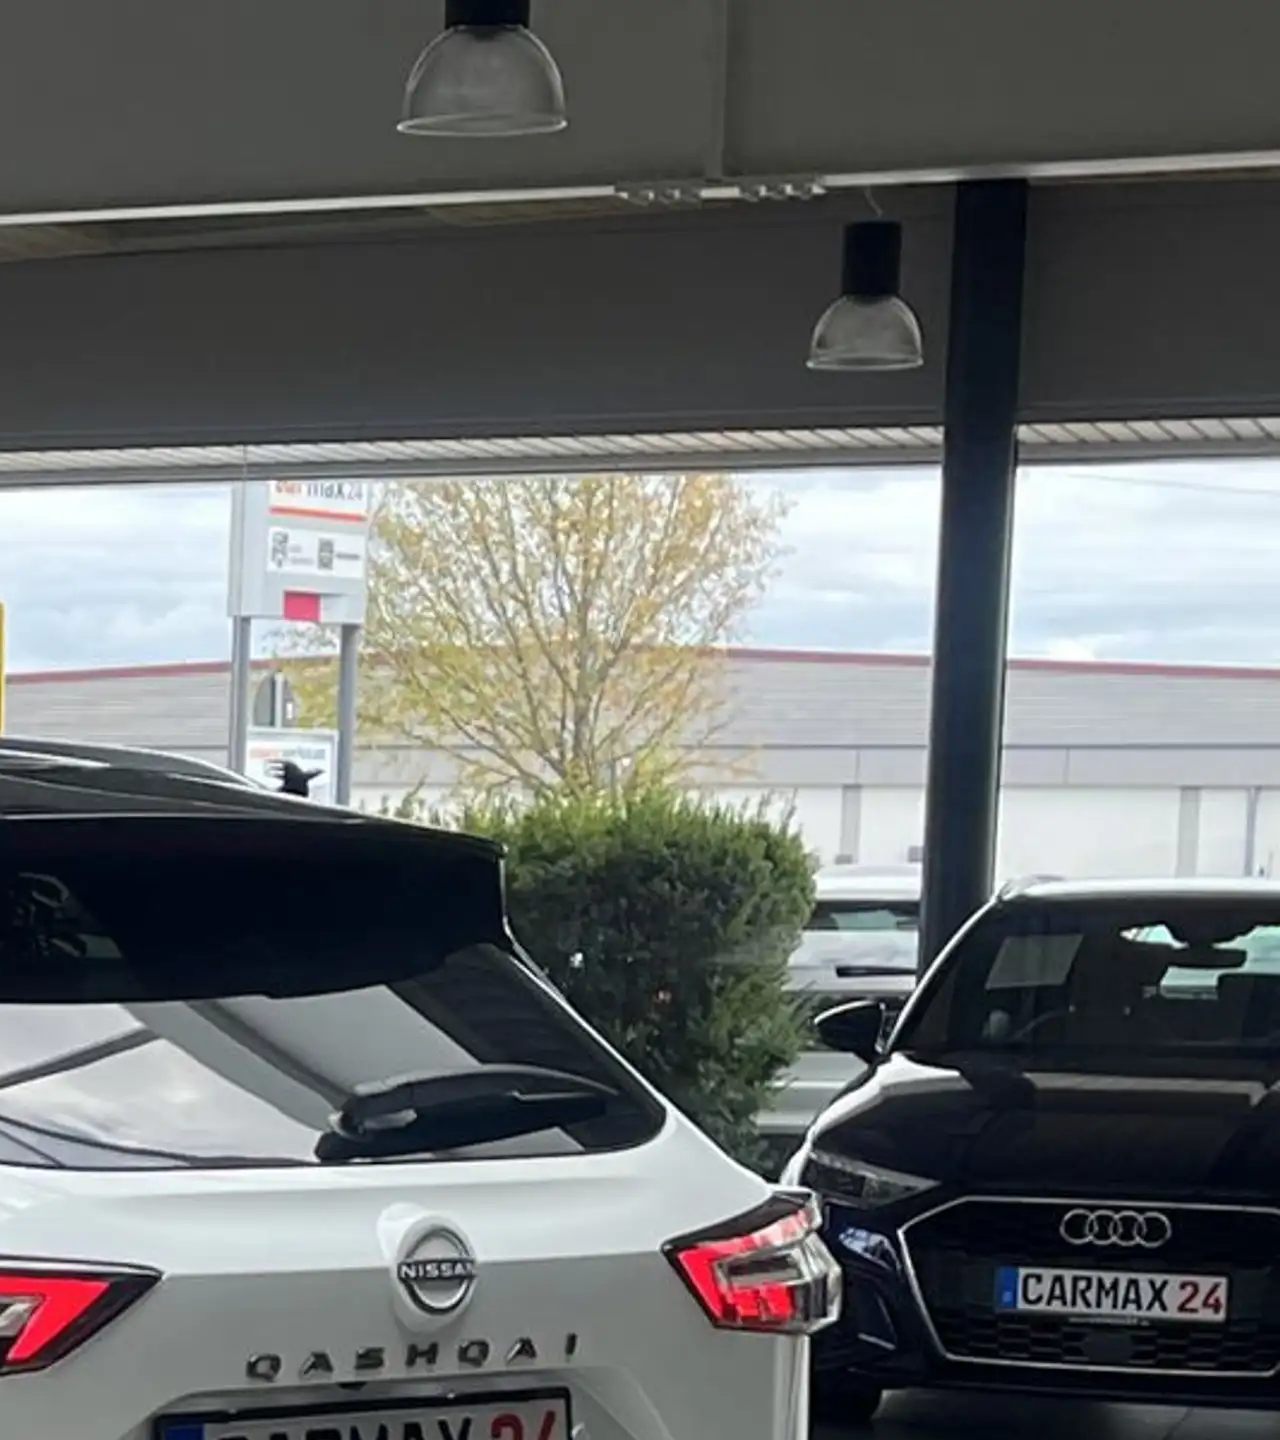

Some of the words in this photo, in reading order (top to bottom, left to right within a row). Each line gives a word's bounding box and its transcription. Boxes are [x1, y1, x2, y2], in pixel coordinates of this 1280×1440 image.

[1022, 1273, 1168, 1312] CARMAX
[1177, 1281, 1223, 1314] 24
[246, 1333, 578, 1382] QASHQAI
